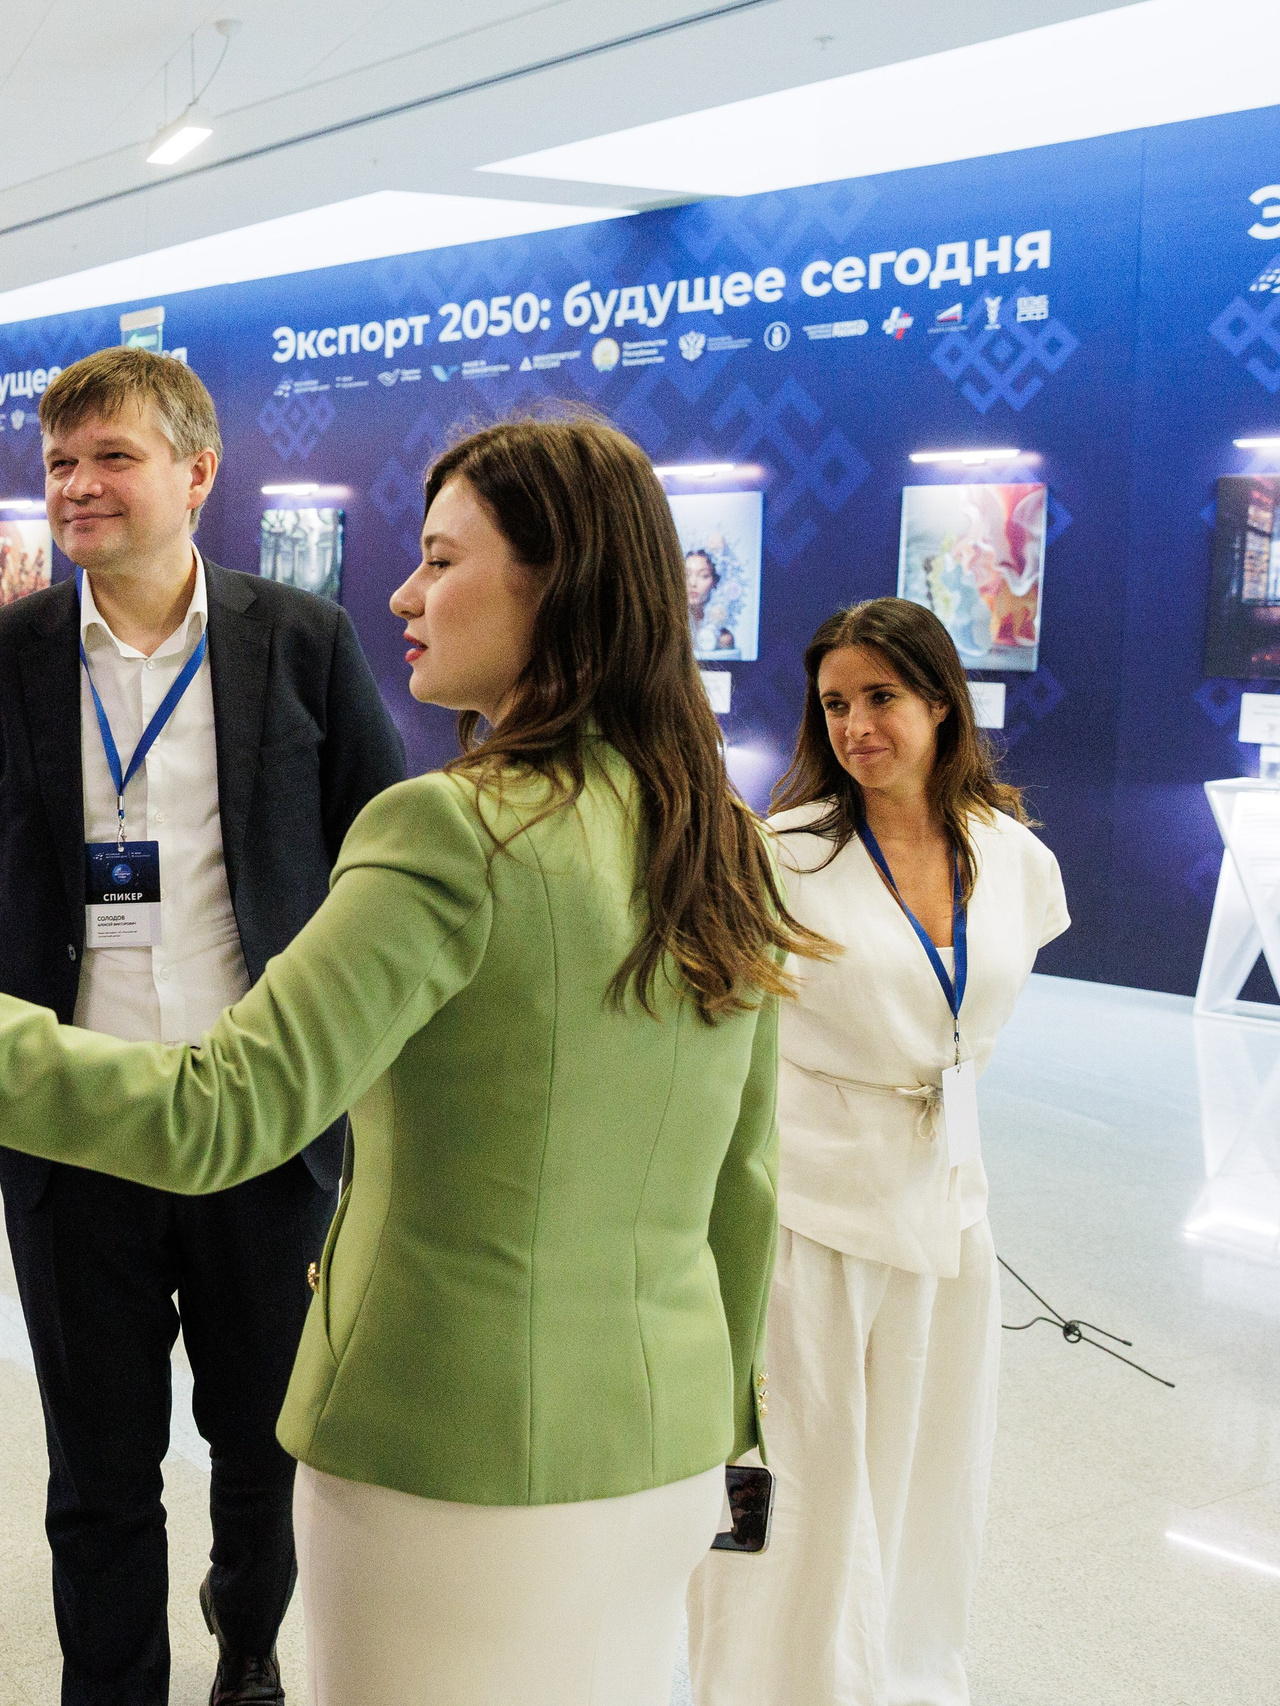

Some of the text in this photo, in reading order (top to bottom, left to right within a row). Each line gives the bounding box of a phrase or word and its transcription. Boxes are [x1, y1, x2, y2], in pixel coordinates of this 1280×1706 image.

[272, 229, 1052, 363] Экспорт 2050: будущее сегодня
[103, 892, 143, 902] СПИКЕР
